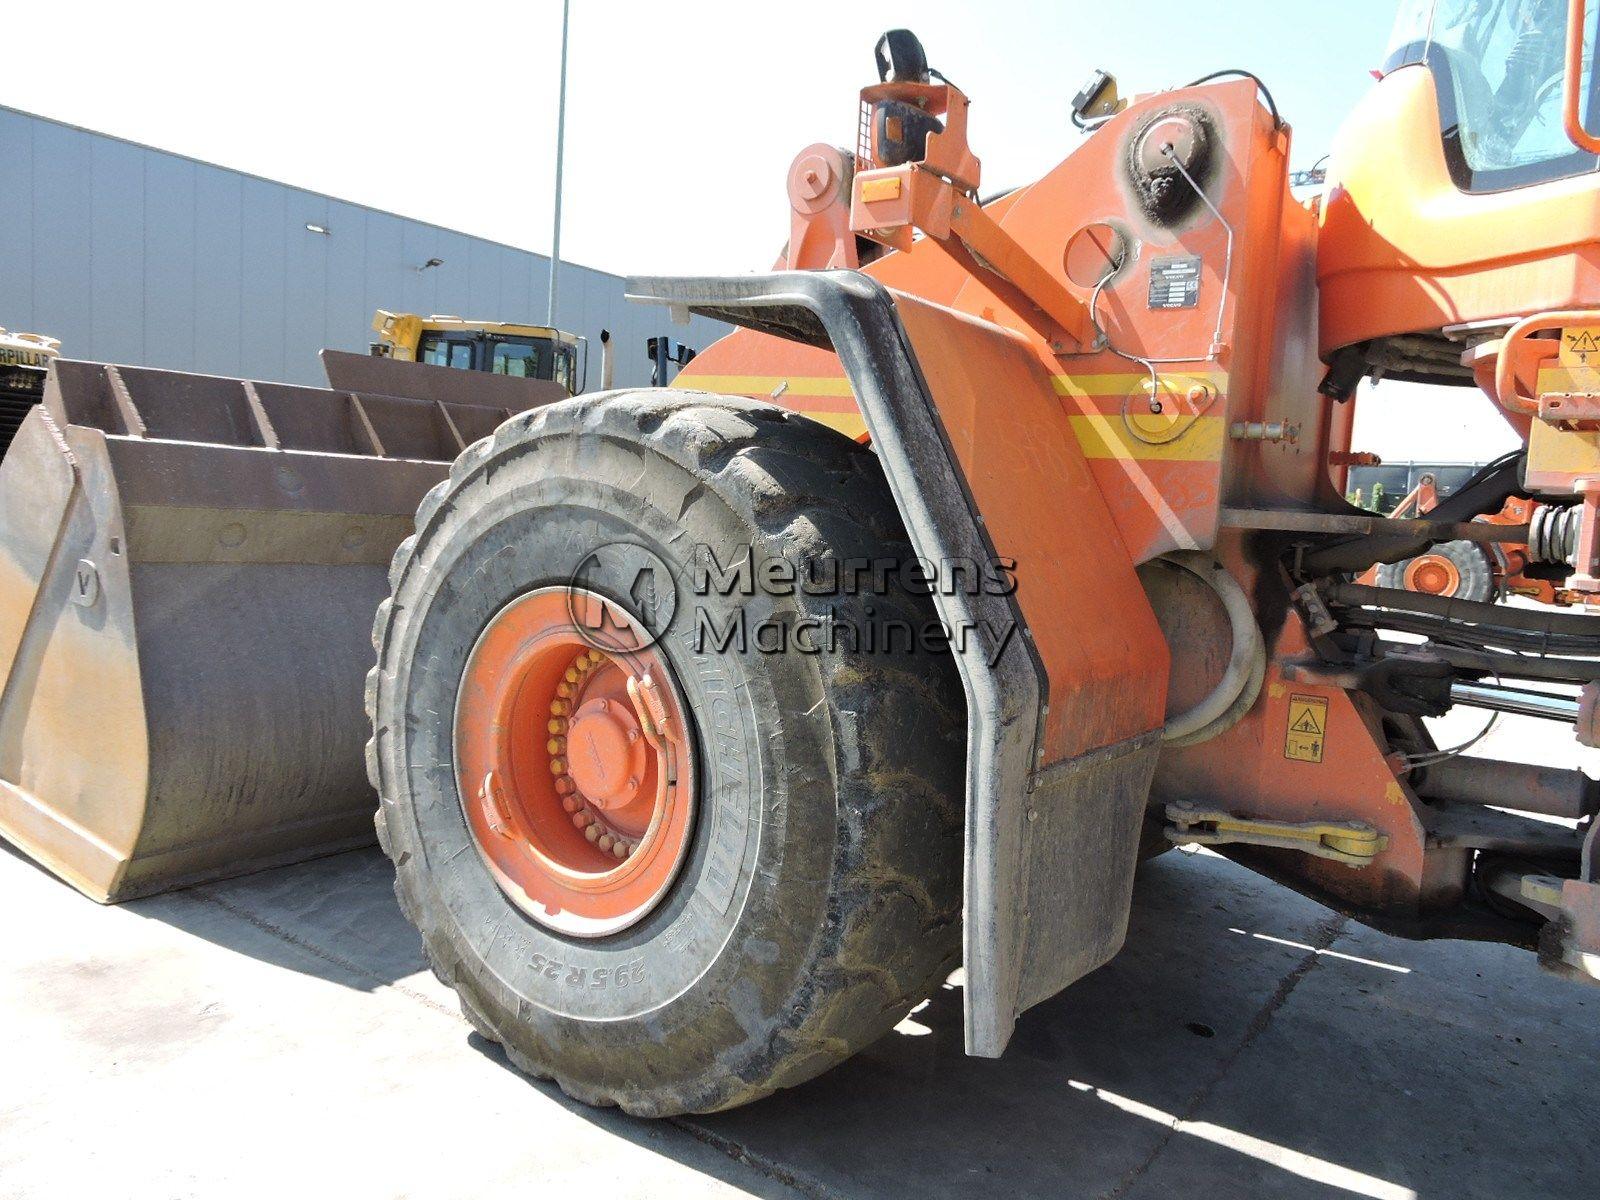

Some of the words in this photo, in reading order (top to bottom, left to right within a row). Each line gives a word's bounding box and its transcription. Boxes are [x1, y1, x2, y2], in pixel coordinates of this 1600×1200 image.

[527, 953, 564, 981] 25
[565, 965, 588, 989] R
[590, 956, 646, 989] 29.5
